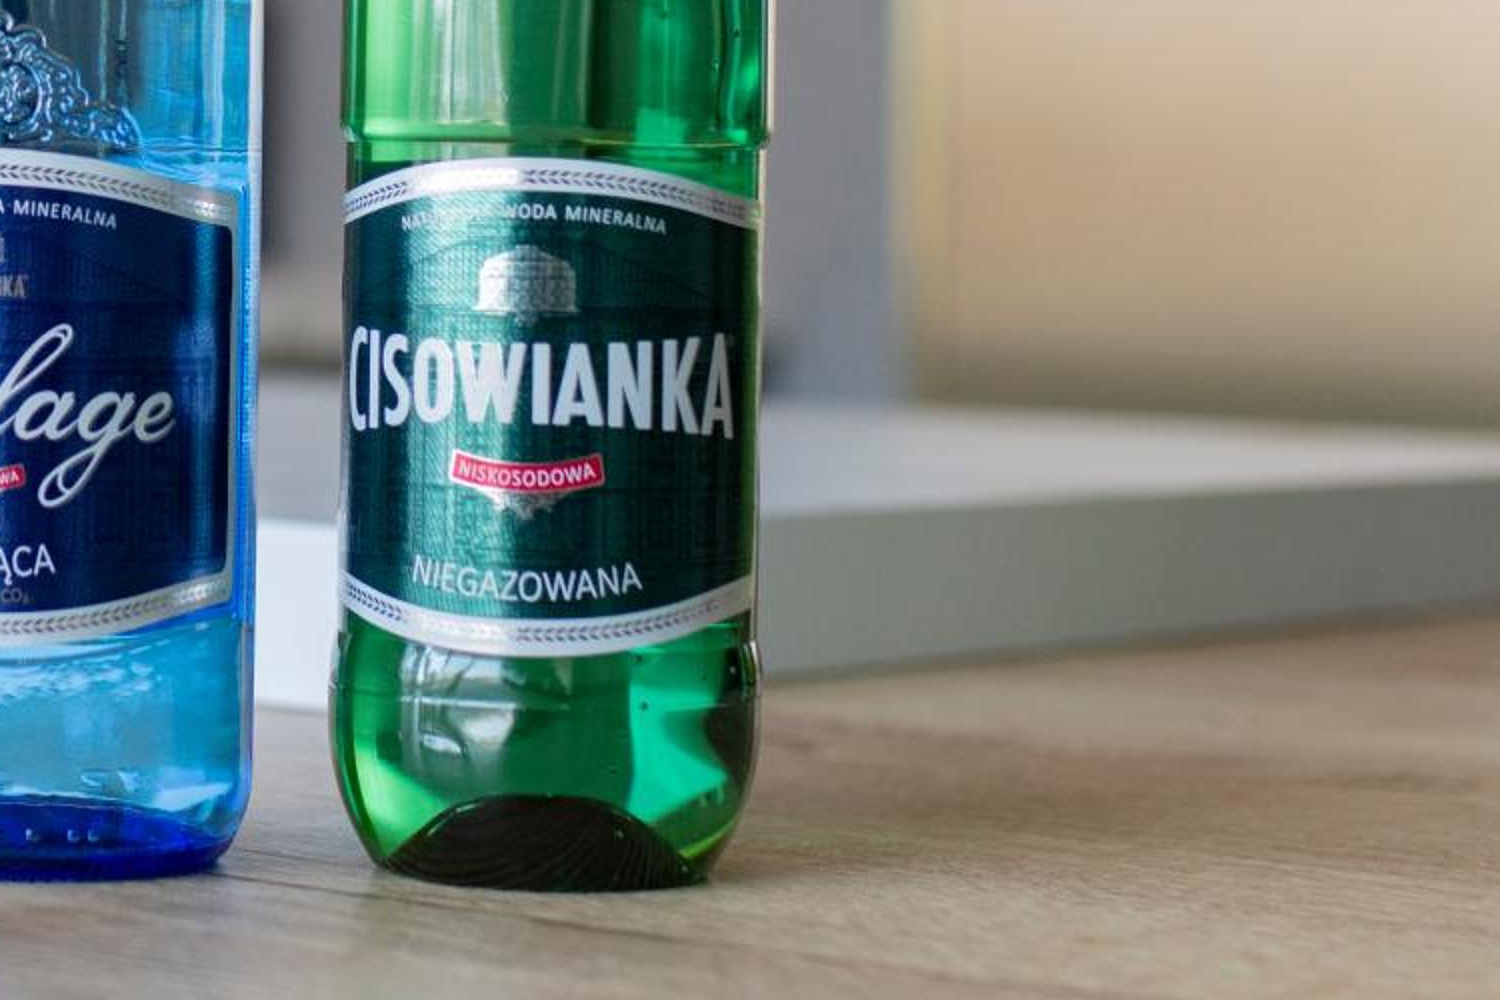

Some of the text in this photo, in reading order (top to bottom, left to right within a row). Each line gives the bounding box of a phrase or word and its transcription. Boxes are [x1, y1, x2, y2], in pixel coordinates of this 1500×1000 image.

[13, 199, 117, 229] MINERALNA
[565, 205, 667, 235] MINERALNA
[349, 326, 734, 440] CISOWIANKA
[458, 462, 597, 488] NISKOSODOWA
[412, 555, 643, 602] NIEGAZOWANA
